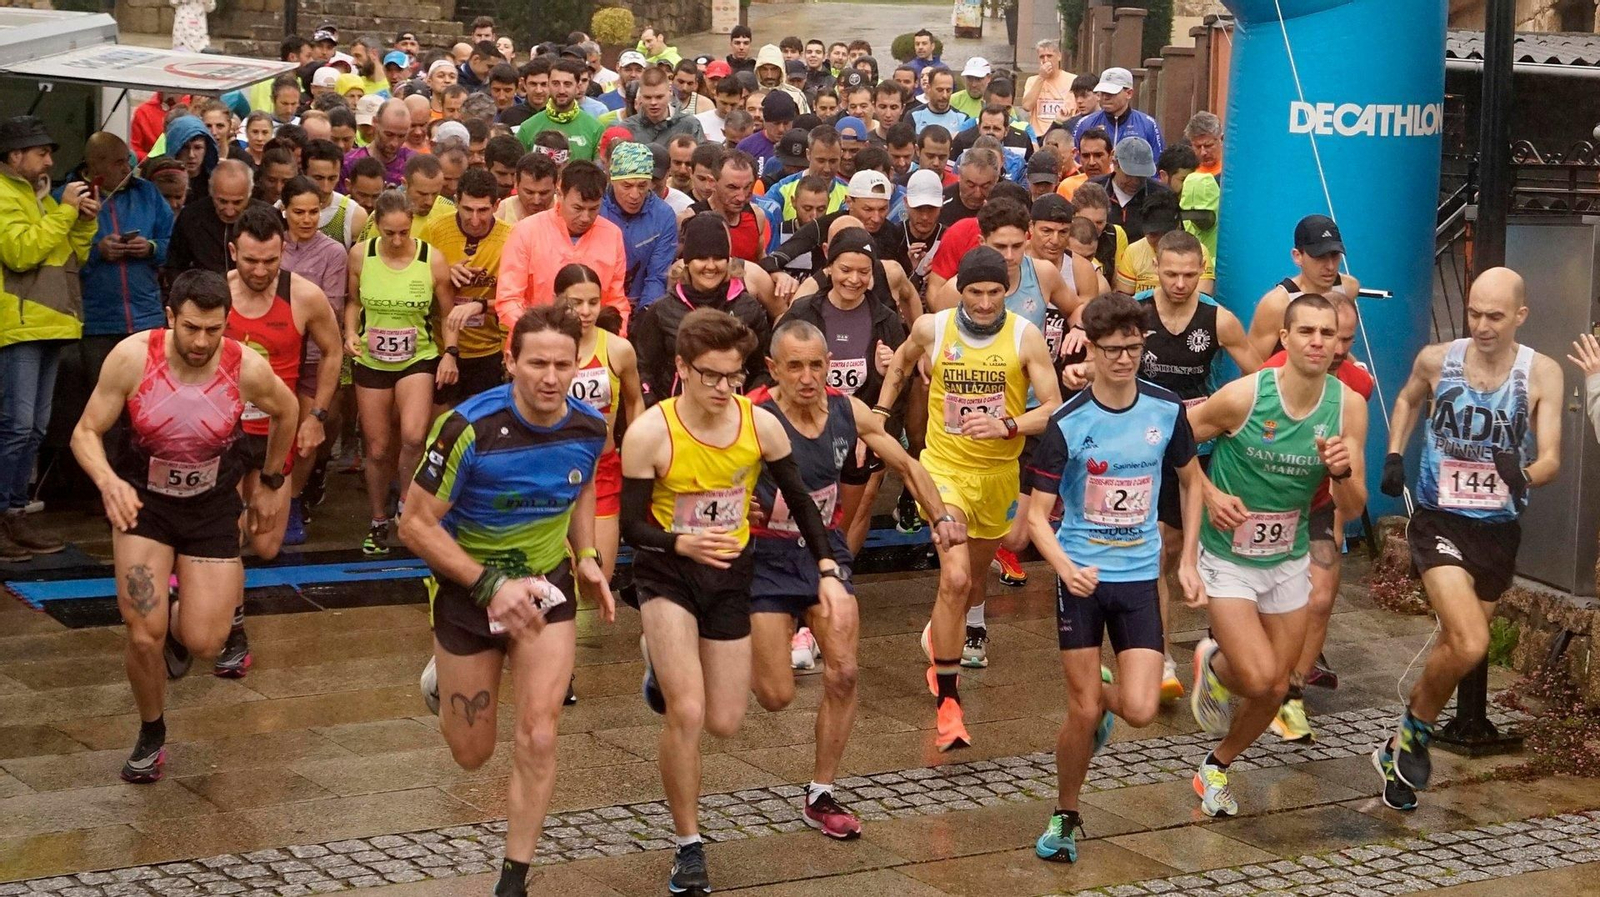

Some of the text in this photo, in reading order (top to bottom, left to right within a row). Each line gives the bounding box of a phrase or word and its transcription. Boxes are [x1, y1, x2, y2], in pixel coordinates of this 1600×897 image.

[1289, 100, 1444, 137] DECATHLON
[376, 335, 409, 352] 251
[831, 369, 858, 388] 36
[943, 368, 1006, 382] ATHLETICS
[572, 379, 601, 401] 02
[945, 382, 1005, 393] SAN LÁZARO
[1433, 400, 1525, 446] ADN
[1246, 446, 1275, 461] SAN
[1113, 462, 1139, 471] Saunier
[1263, 464, 1310, 476] MARIN
[168, 469, 200, 487] 56
[1451, 470, 1497, 493] 144
[1113, 489, 1128, 511] 2
[704, 500, 719, 521] 4
[1253, 523, 1283, 543] 39
